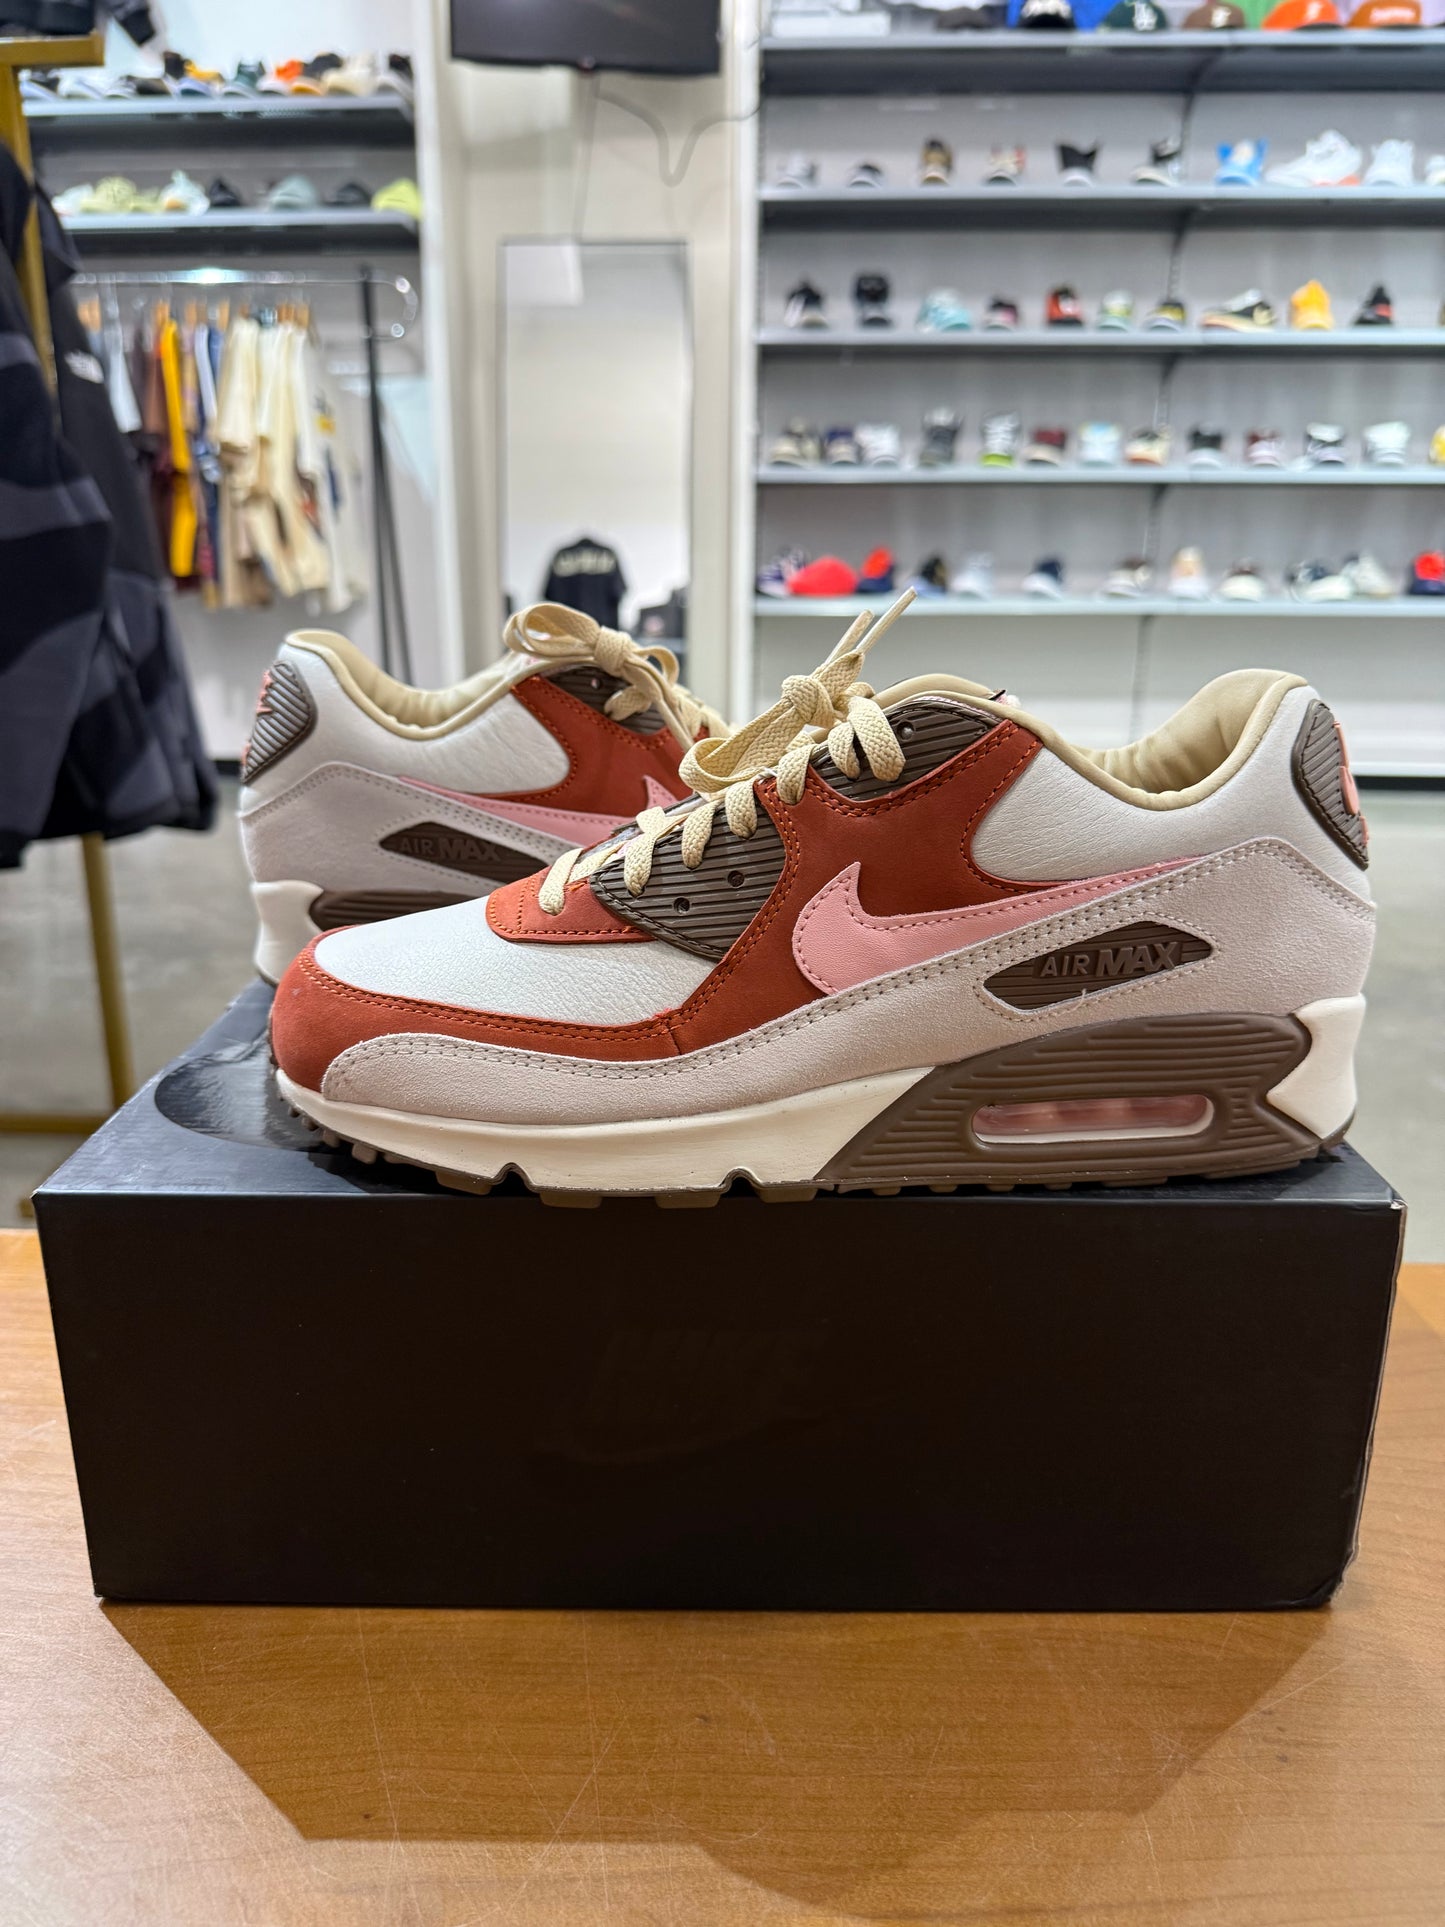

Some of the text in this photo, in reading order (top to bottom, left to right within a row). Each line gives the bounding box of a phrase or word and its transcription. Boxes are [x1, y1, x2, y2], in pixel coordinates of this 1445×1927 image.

[399, 837, 500, 861] AIR MAX
[1040, 941, 1178, 977] AIR MAX
